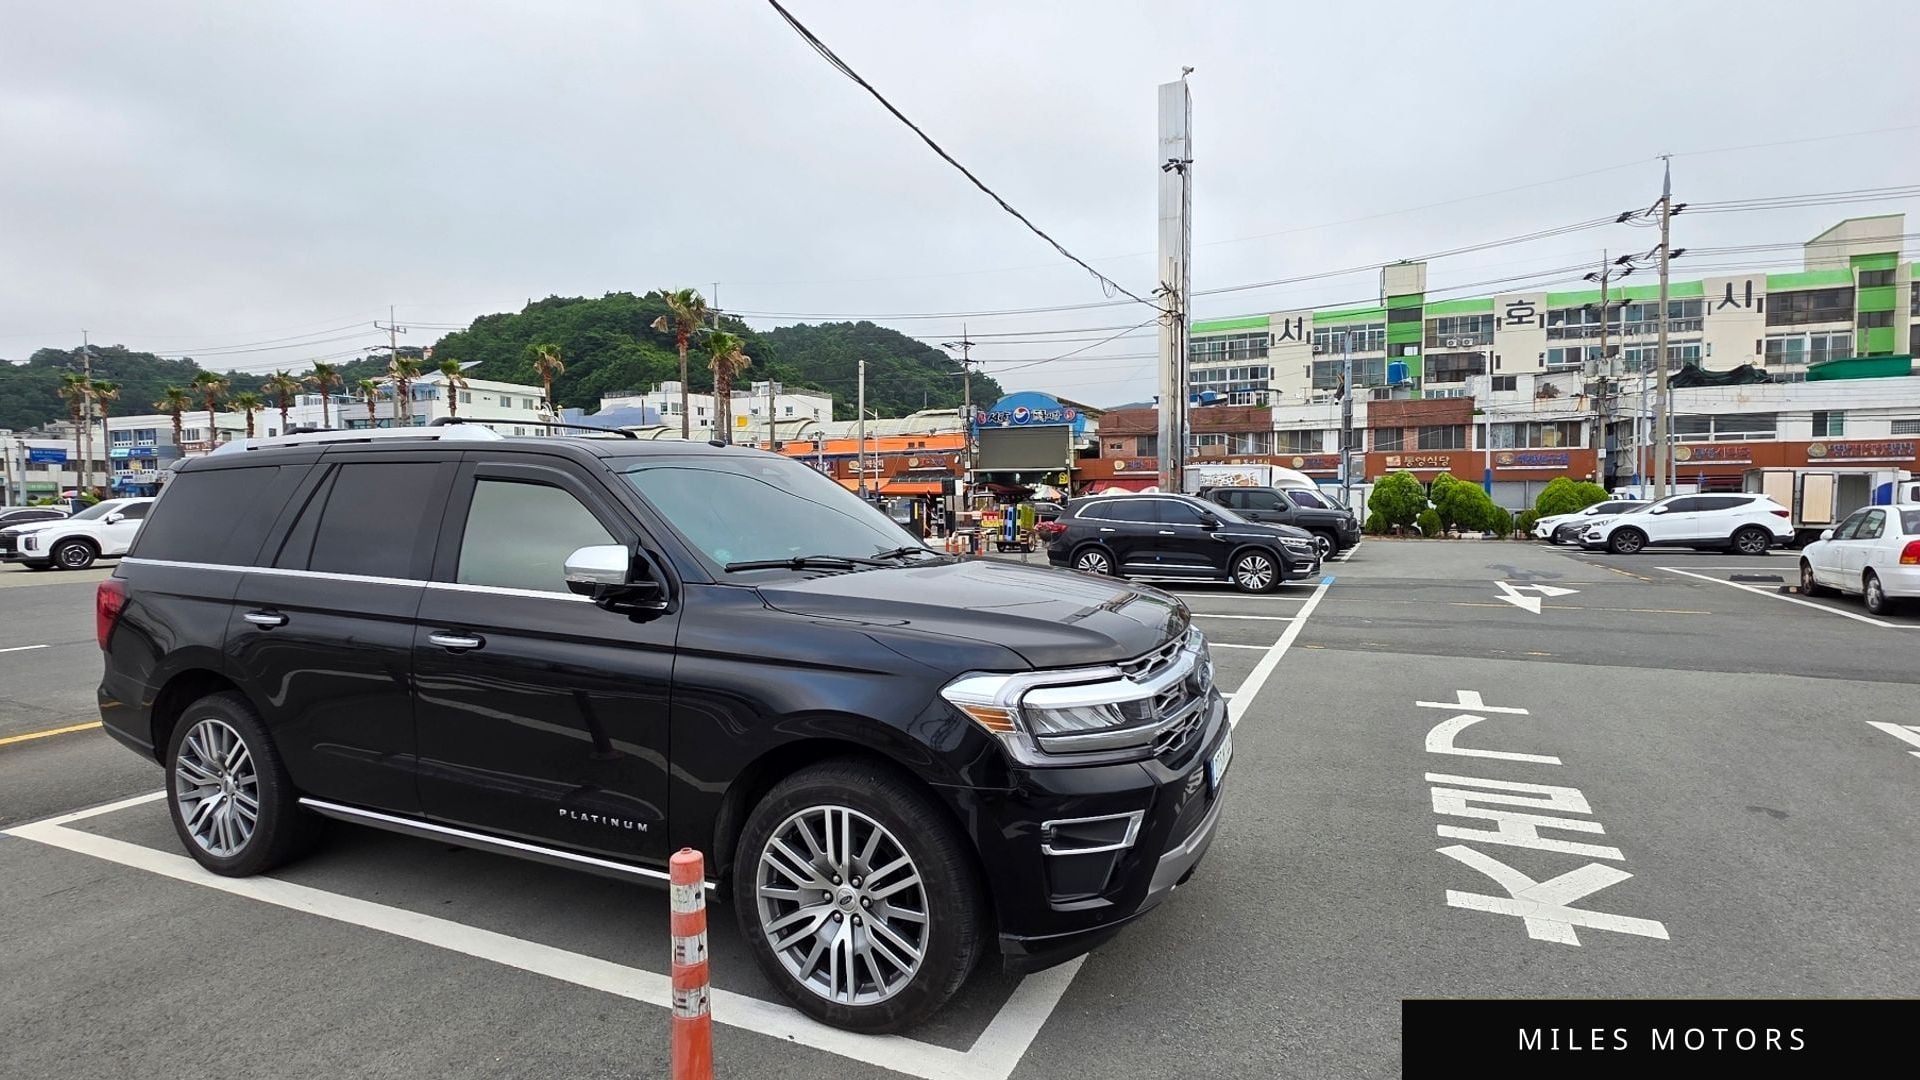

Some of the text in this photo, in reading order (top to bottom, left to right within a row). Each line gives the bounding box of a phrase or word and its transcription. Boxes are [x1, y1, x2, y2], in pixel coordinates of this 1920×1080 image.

[1278, 279, 1752, 341] 서 호 시
[1403, 455, 1450, 467] 통영식당
[559, 808, 648, 832] PLATINUM
[1416, 690, 1670, 946] 출구
